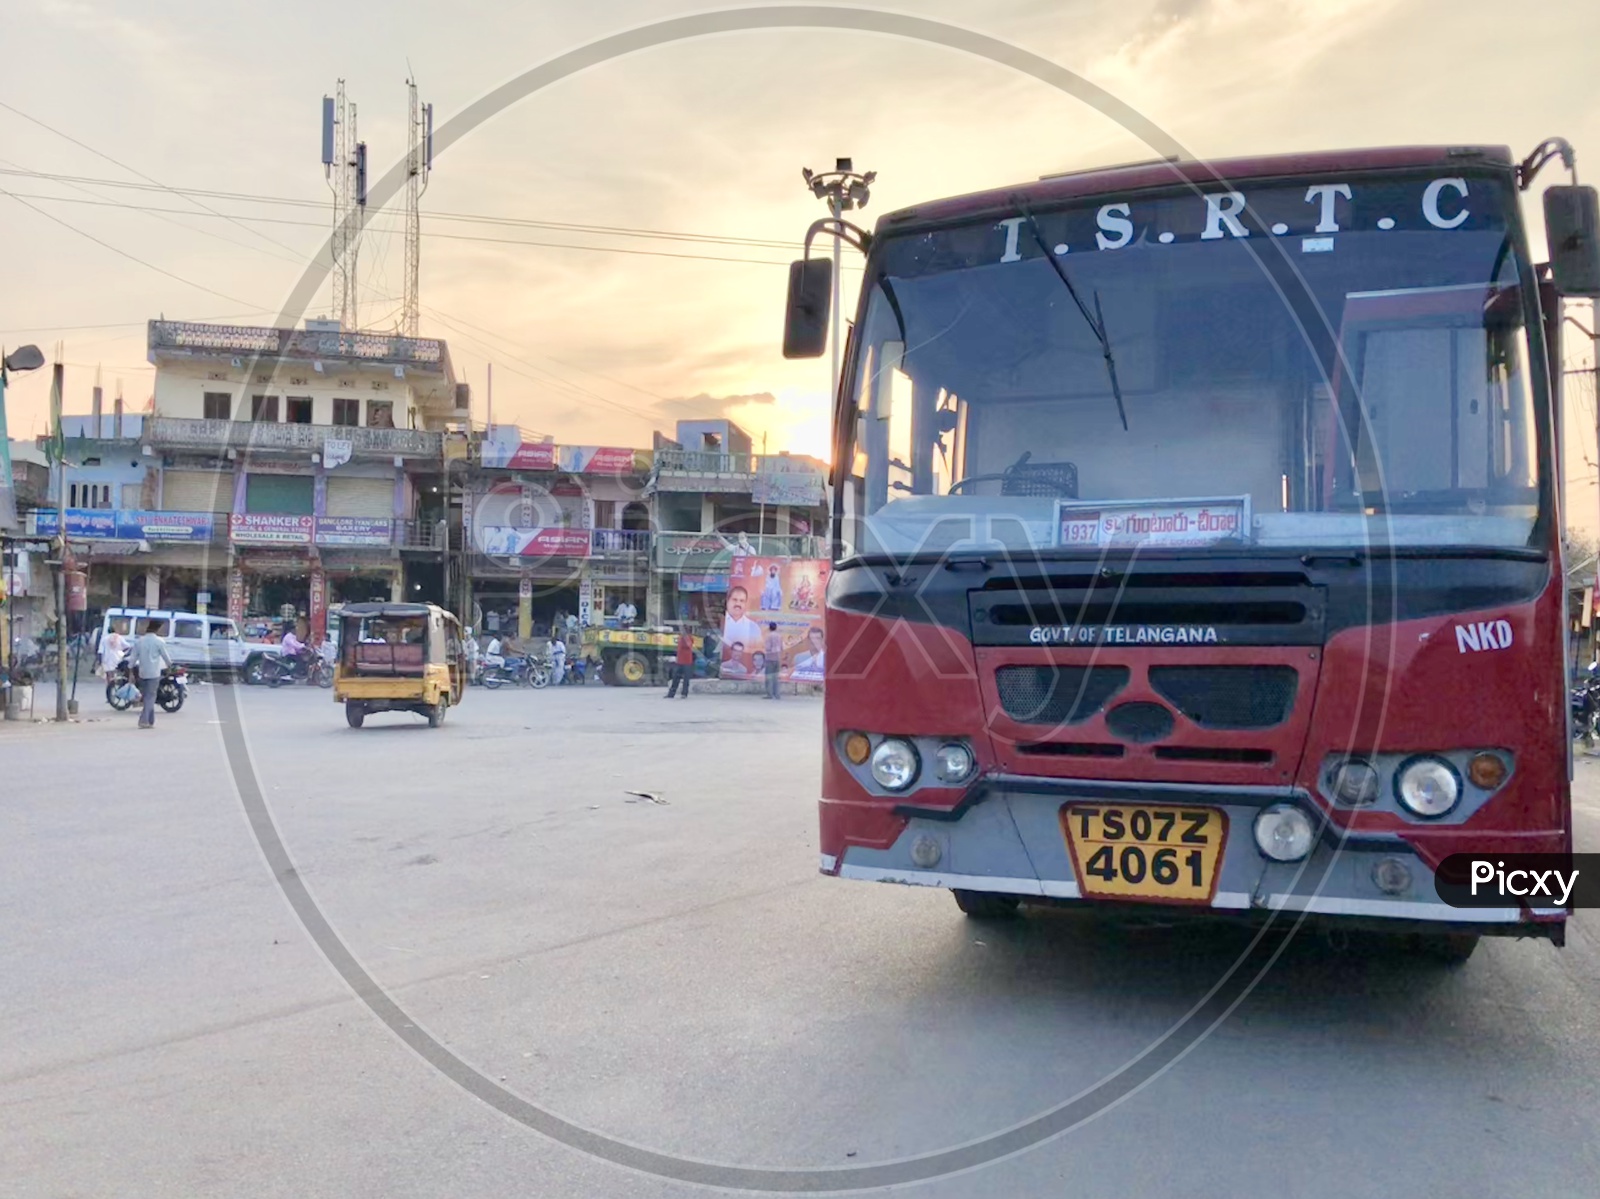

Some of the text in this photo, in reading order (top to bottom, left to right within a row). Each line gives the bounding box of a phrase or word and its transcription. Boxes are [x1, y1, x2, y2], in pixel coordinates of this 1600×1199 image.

[518, 450, 551, 458] ASIAN
[245, 514, 299, 527] SHANKER
[1105, 519, 1122, 531] SL
[1063, 524, 1096, 541] 1937
[538, 536, 588, 545] ASIAN
[1079, 627, 1095, 642] OF
[1455, 619, 1513, 654] NKD
[1071, 808, 1210, 845] TS07Z
[1086, 845, 1203, 887] 4061
